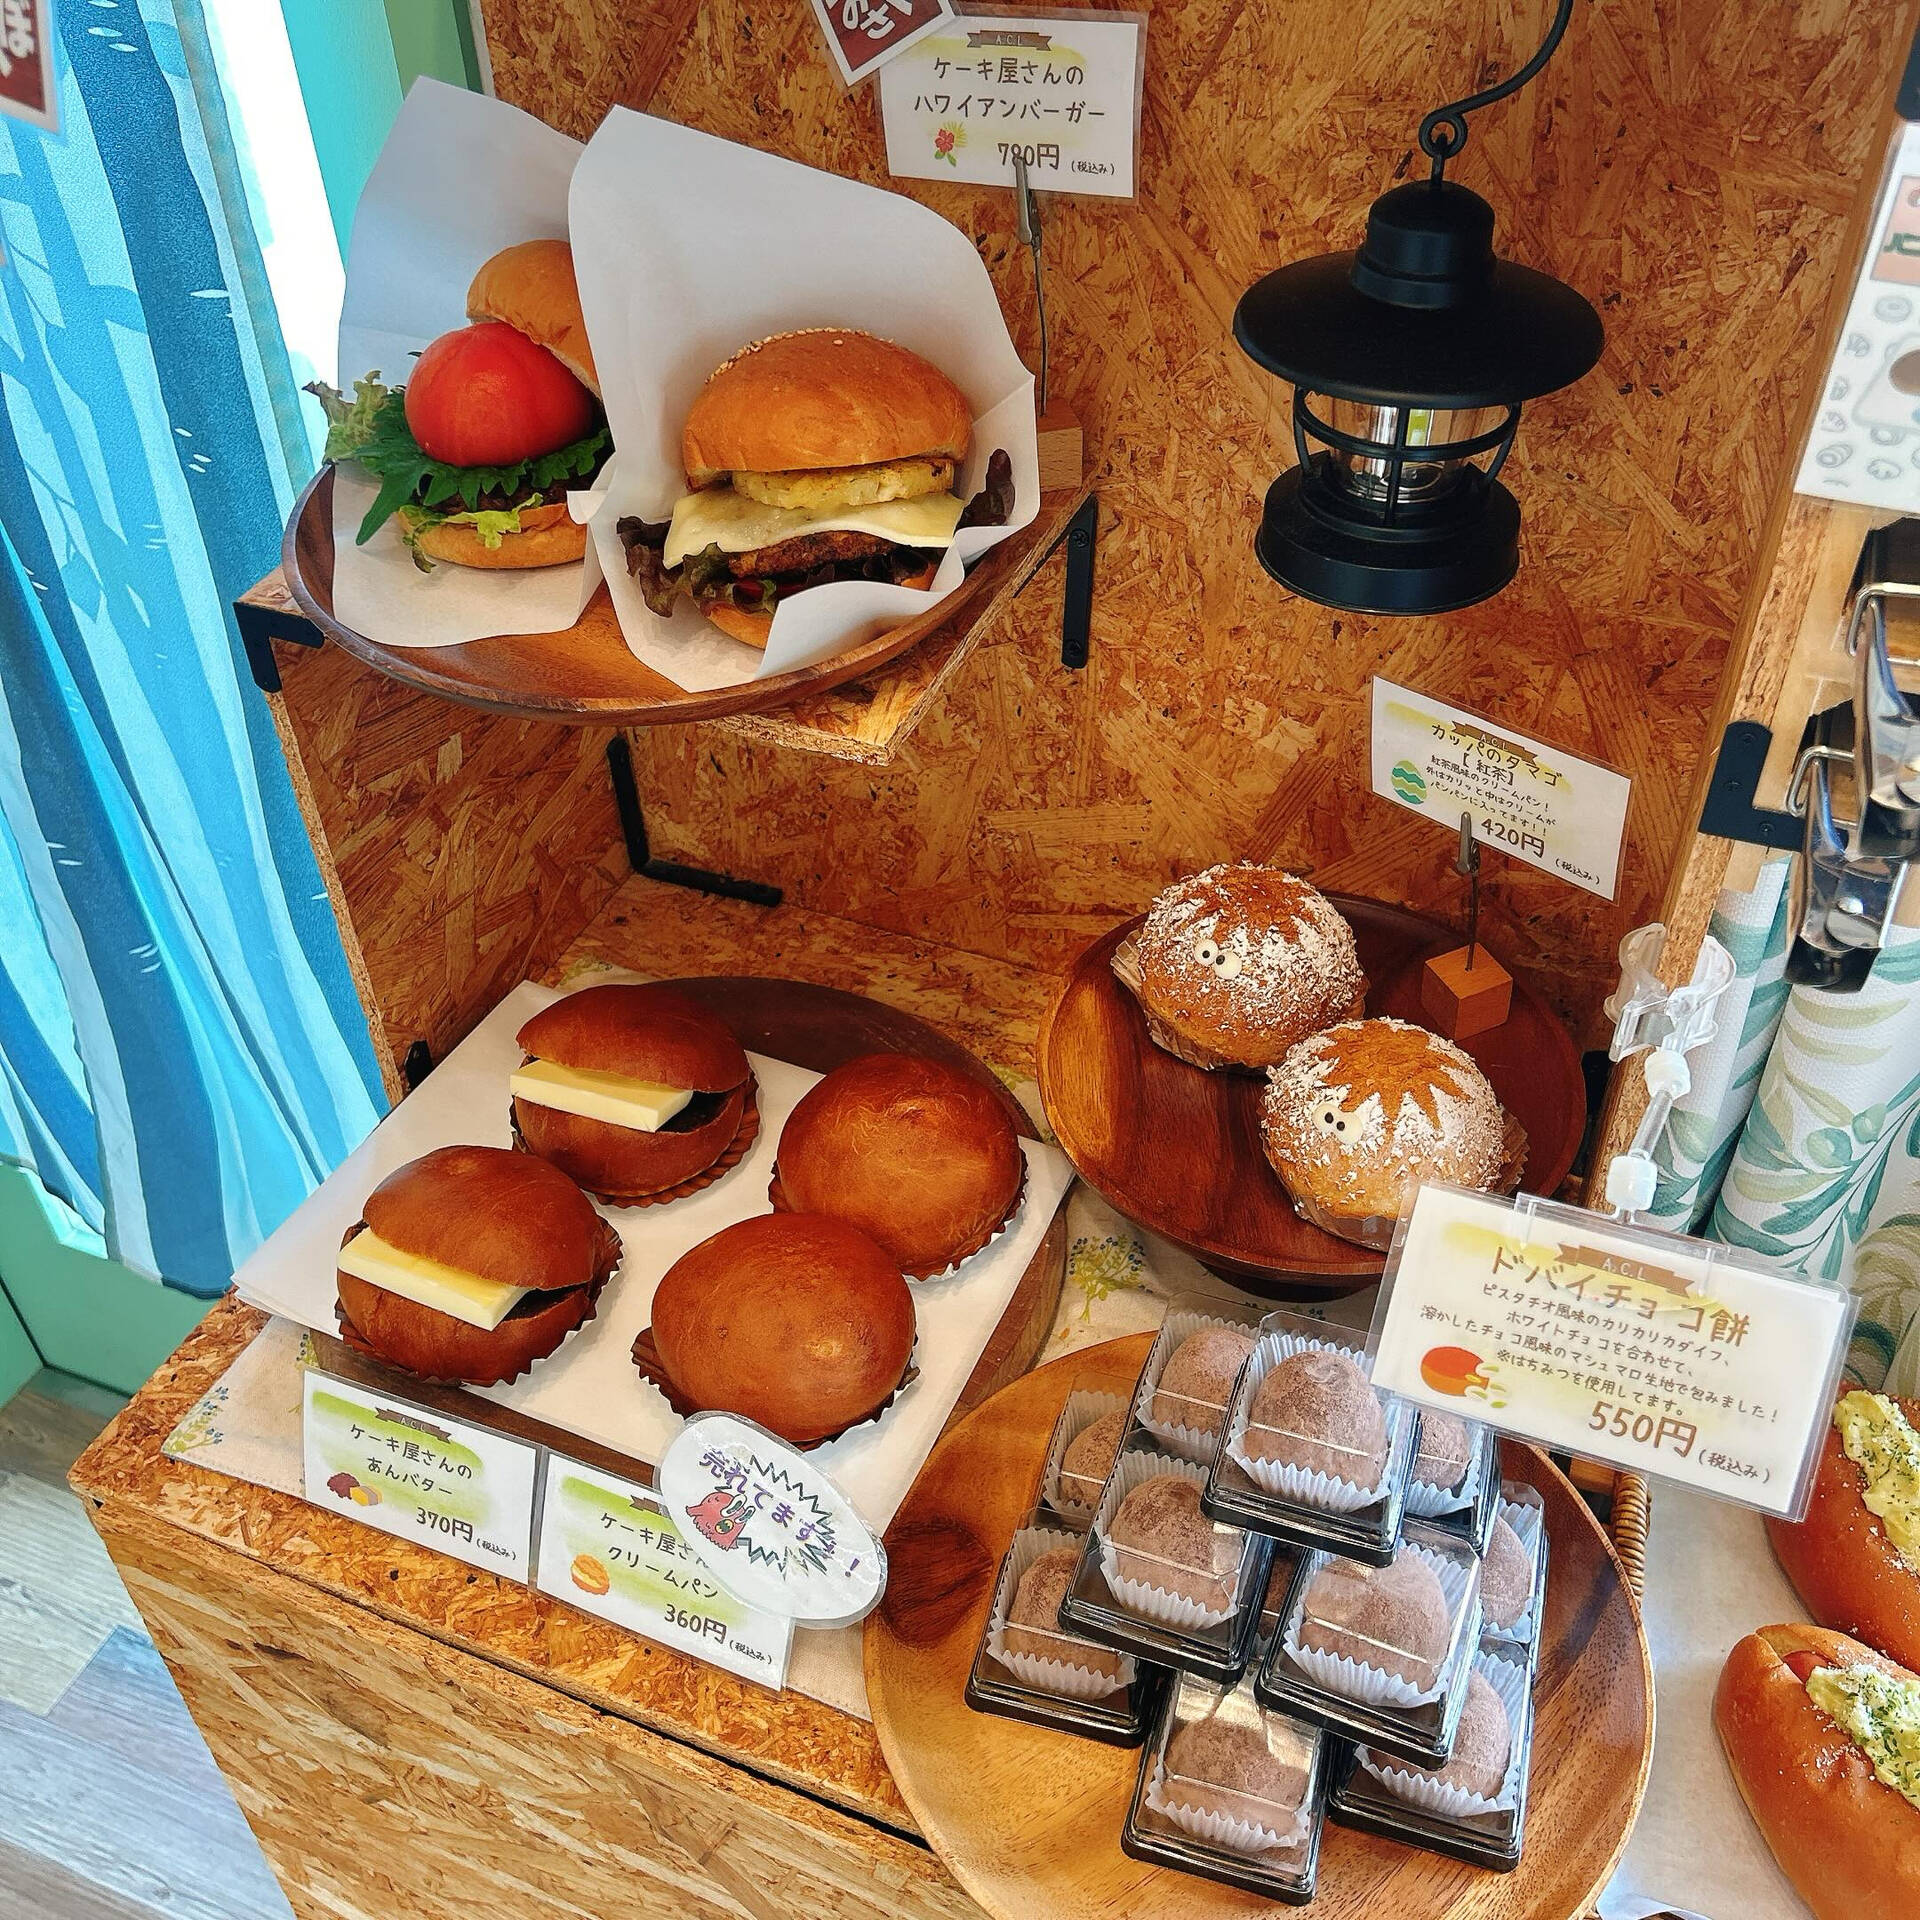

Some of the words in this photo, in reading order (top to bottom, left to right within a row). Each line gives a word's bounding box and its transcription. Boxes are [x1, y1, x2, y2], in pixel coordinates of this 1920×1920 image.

[934, 57, 1084, 84] ケーキ屋さんの
[914, 94, 1105, 123] ハワイアンバーガー
[1431, 725, 1563, 786] カッパのタマゴ
[1462, 752, 1514, 786] 【紅茶】
[1481, 818, 1545, 858] 420円
[1493, 1246, 1750, 1347] ドバイチョコ餅
[1483, 1283, 1729, 1366] ピスタチオ風味のカリカリカダイフ、
[1506, 1312, 1693, 1377] ホワイトチョコを合わせて、
[350, 1424, 472, 1480] ケーキ屋さんの
[1589, 1400, 1697, 1458] 550円
[367, 1457, 453, 1495] あんバター
[416, 1507, 473, 1543] 370円
[608, 1546, 718, 1598] クリームパン
[664, 1603, 727, 1644] 360円
